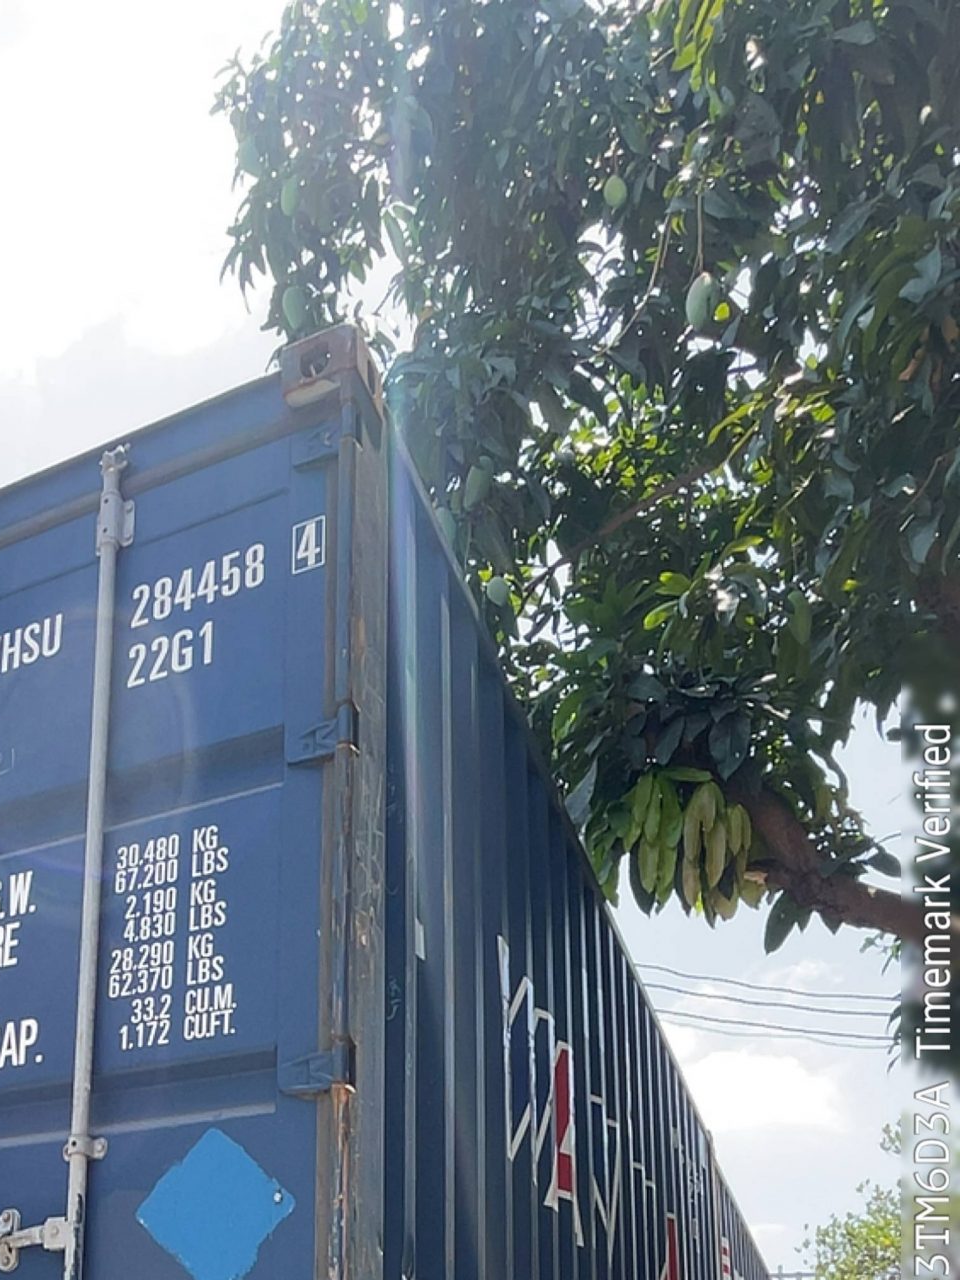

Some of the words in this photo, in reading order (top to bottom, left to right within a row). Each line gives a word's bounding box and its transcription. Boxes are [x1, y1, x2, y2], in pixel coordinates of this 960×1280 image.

[131, 543, 265, 629] 284458
[297, 521, 321, 567] 4
[127, 620, 213, 688] 22G1
[193, 825, 219, 852] KG
[192, 847, 229, 877] LBS
[191, 879, 216, 906] KG
[189, 901, 227, 931] LBS
[188, 933, 214, 959] KG
[186, 956, 224, 986] LBS
[185, 983, 237, 1015] CU.M.
[183, 1009, 236, 1041] CU.FT.
